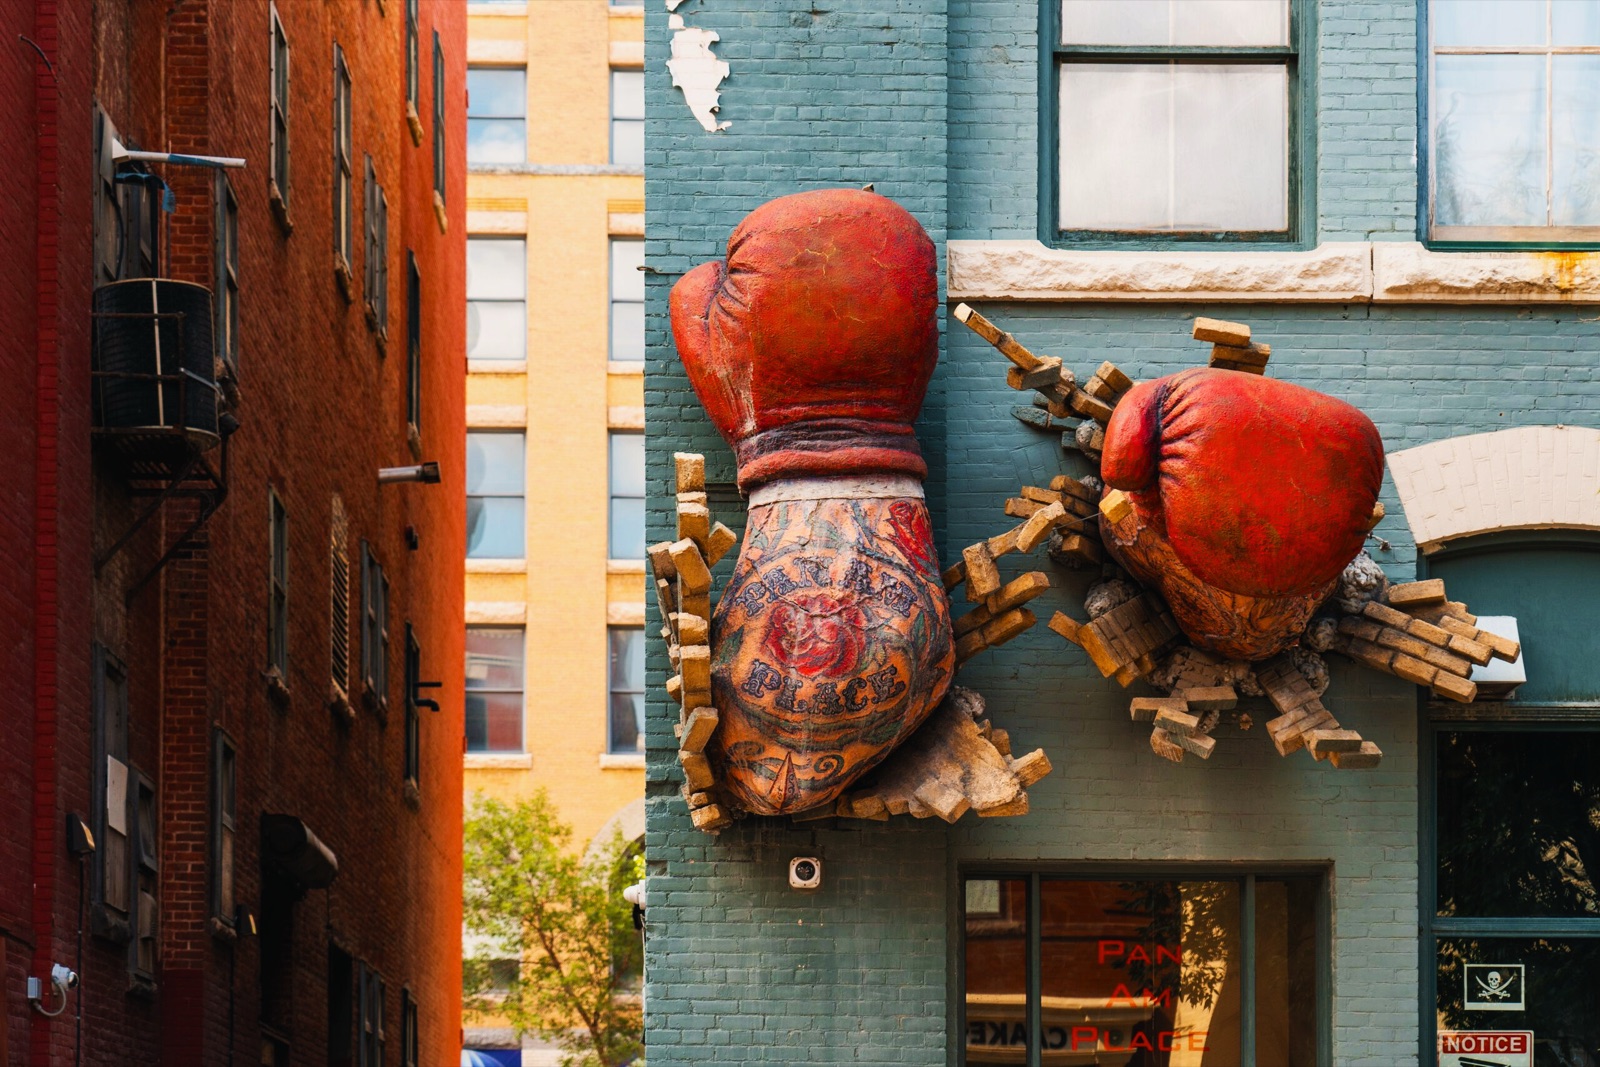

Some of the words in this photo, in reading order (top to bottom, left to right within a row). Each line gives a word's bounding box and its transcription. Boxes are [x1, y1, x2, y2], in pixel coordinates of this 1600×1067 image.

[736, 556, 832, 617] PAN
[838, 557, 918, 618] AM
[741, 659, 906, 715] PLACE
[1097, 940, 1183, 965] PAN
[1105, 983, 1172, 1009] AM
[1071, 1026, 1211, 1052] PLACE
[1447, 1036, 1522, 1052] NOTICE
